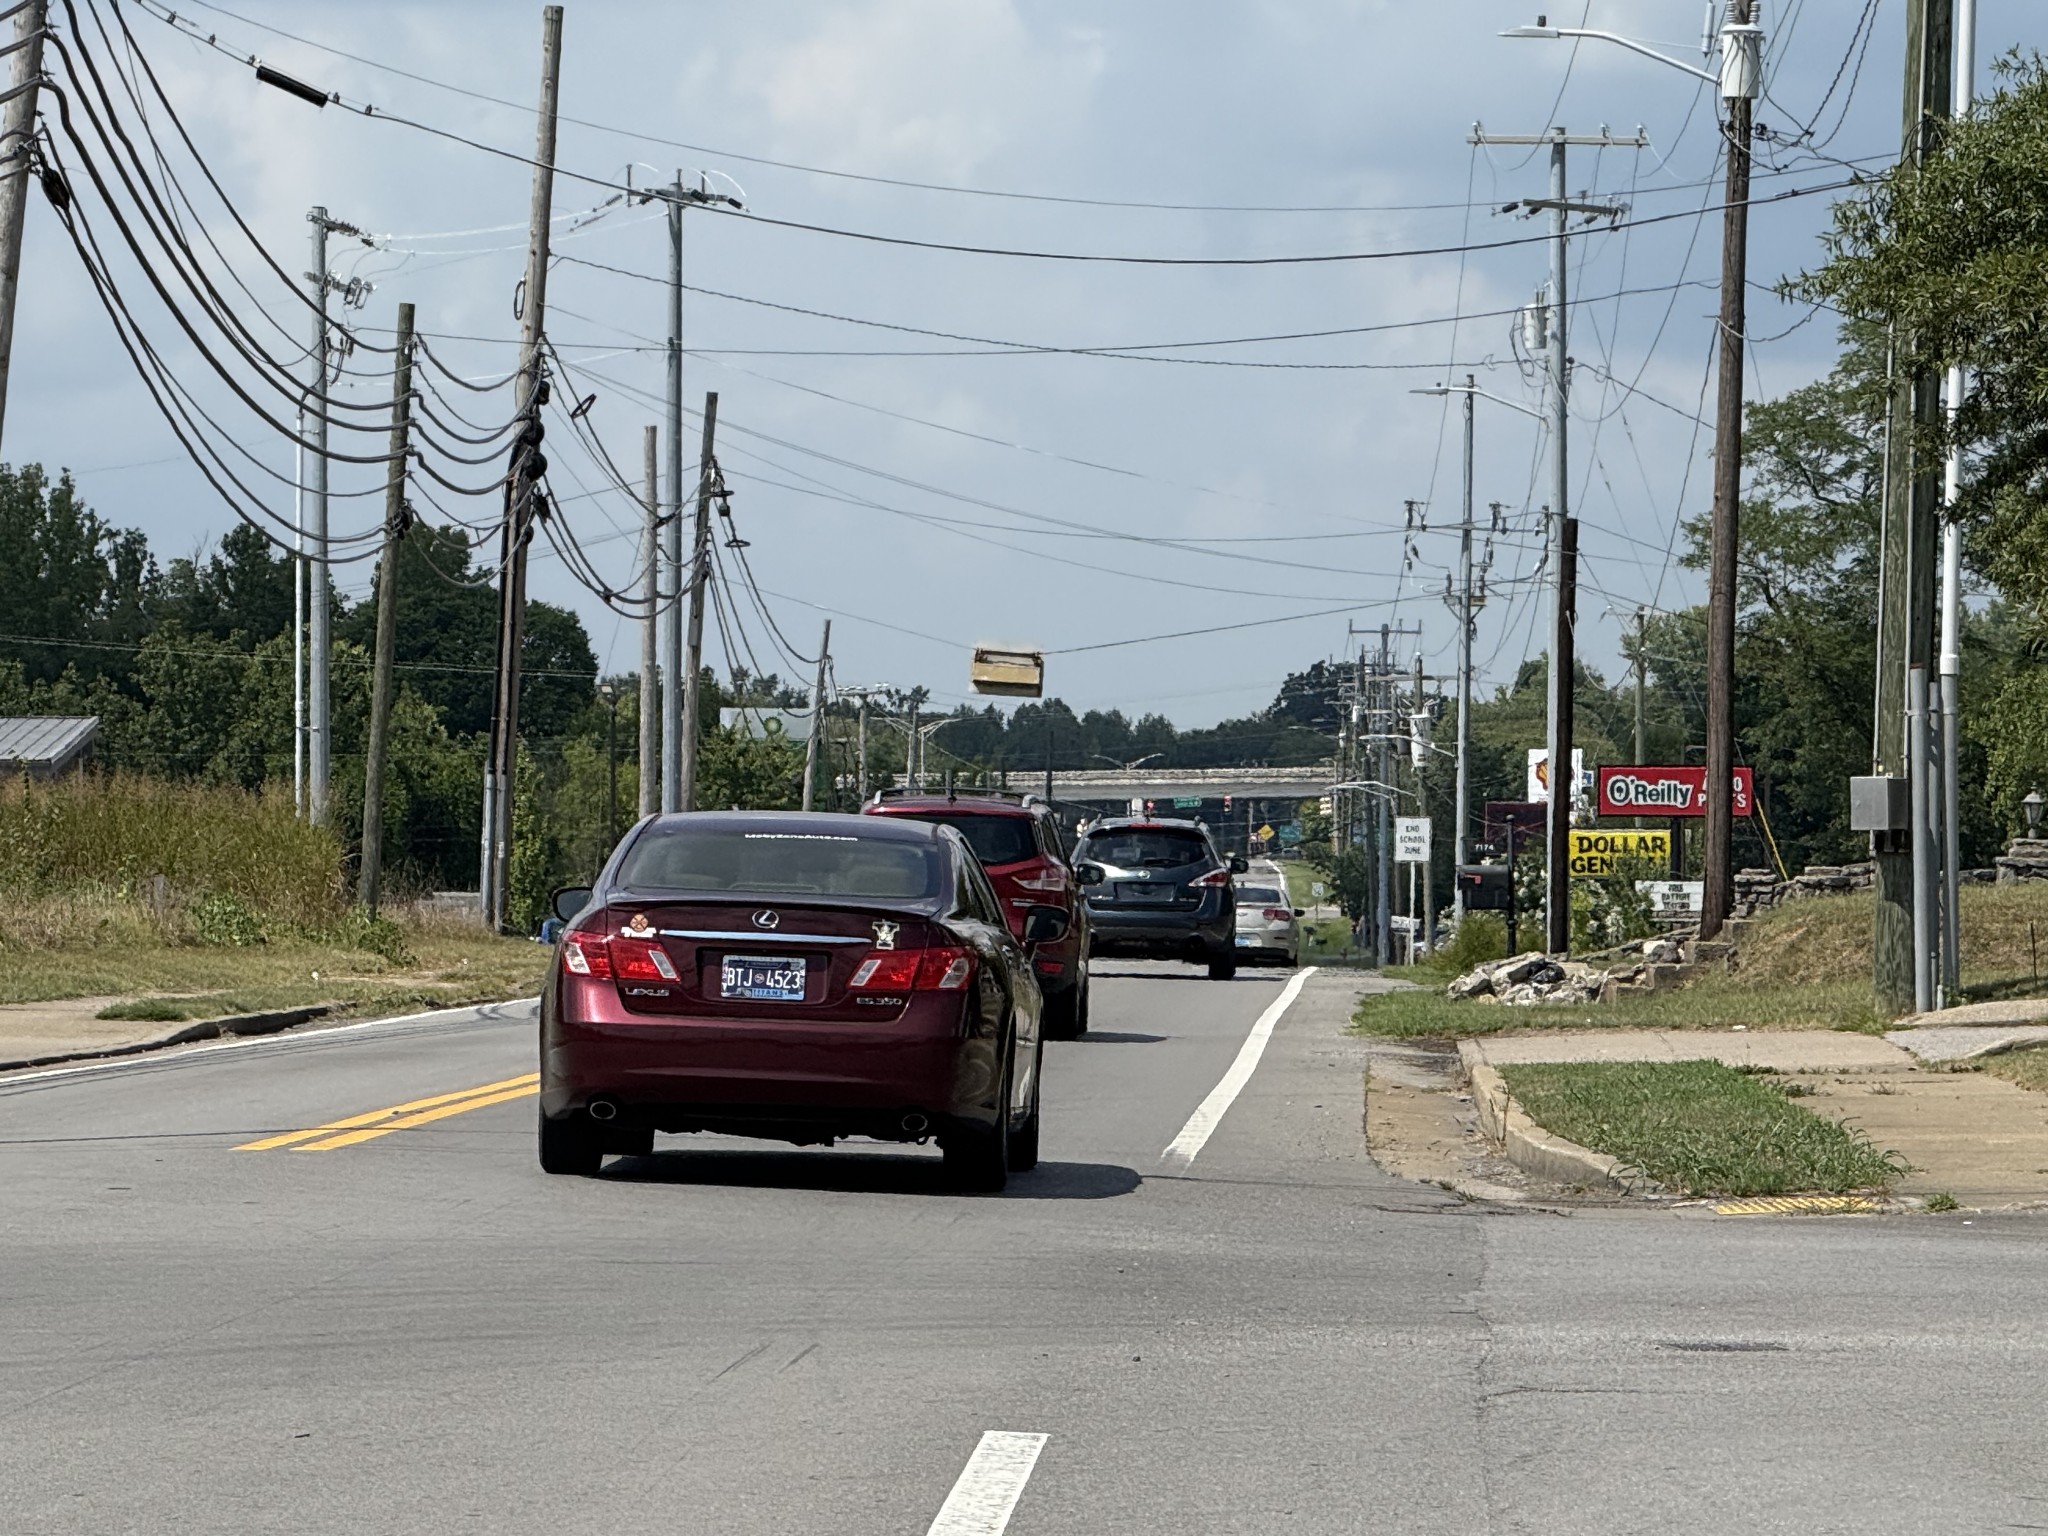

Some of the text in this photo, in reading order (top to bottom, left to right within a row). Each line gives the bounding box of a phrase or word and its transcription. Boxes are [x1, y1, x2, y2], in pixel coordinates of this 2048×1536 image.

[1608, 777, 1692, 807] O'Reilly
[1406, 825, 1419, 833] END
[1400, 835, 1426, 843] SCHOOL
[1474, 843, 1495, 851] 7174
[1576, 836, 1667, 854] DOLLAR
[1405, 846, 1421, 854] ZONE
[727, 968, 801, 989] BTJ 4523
[625, 987, 670, 997] LEXUS
